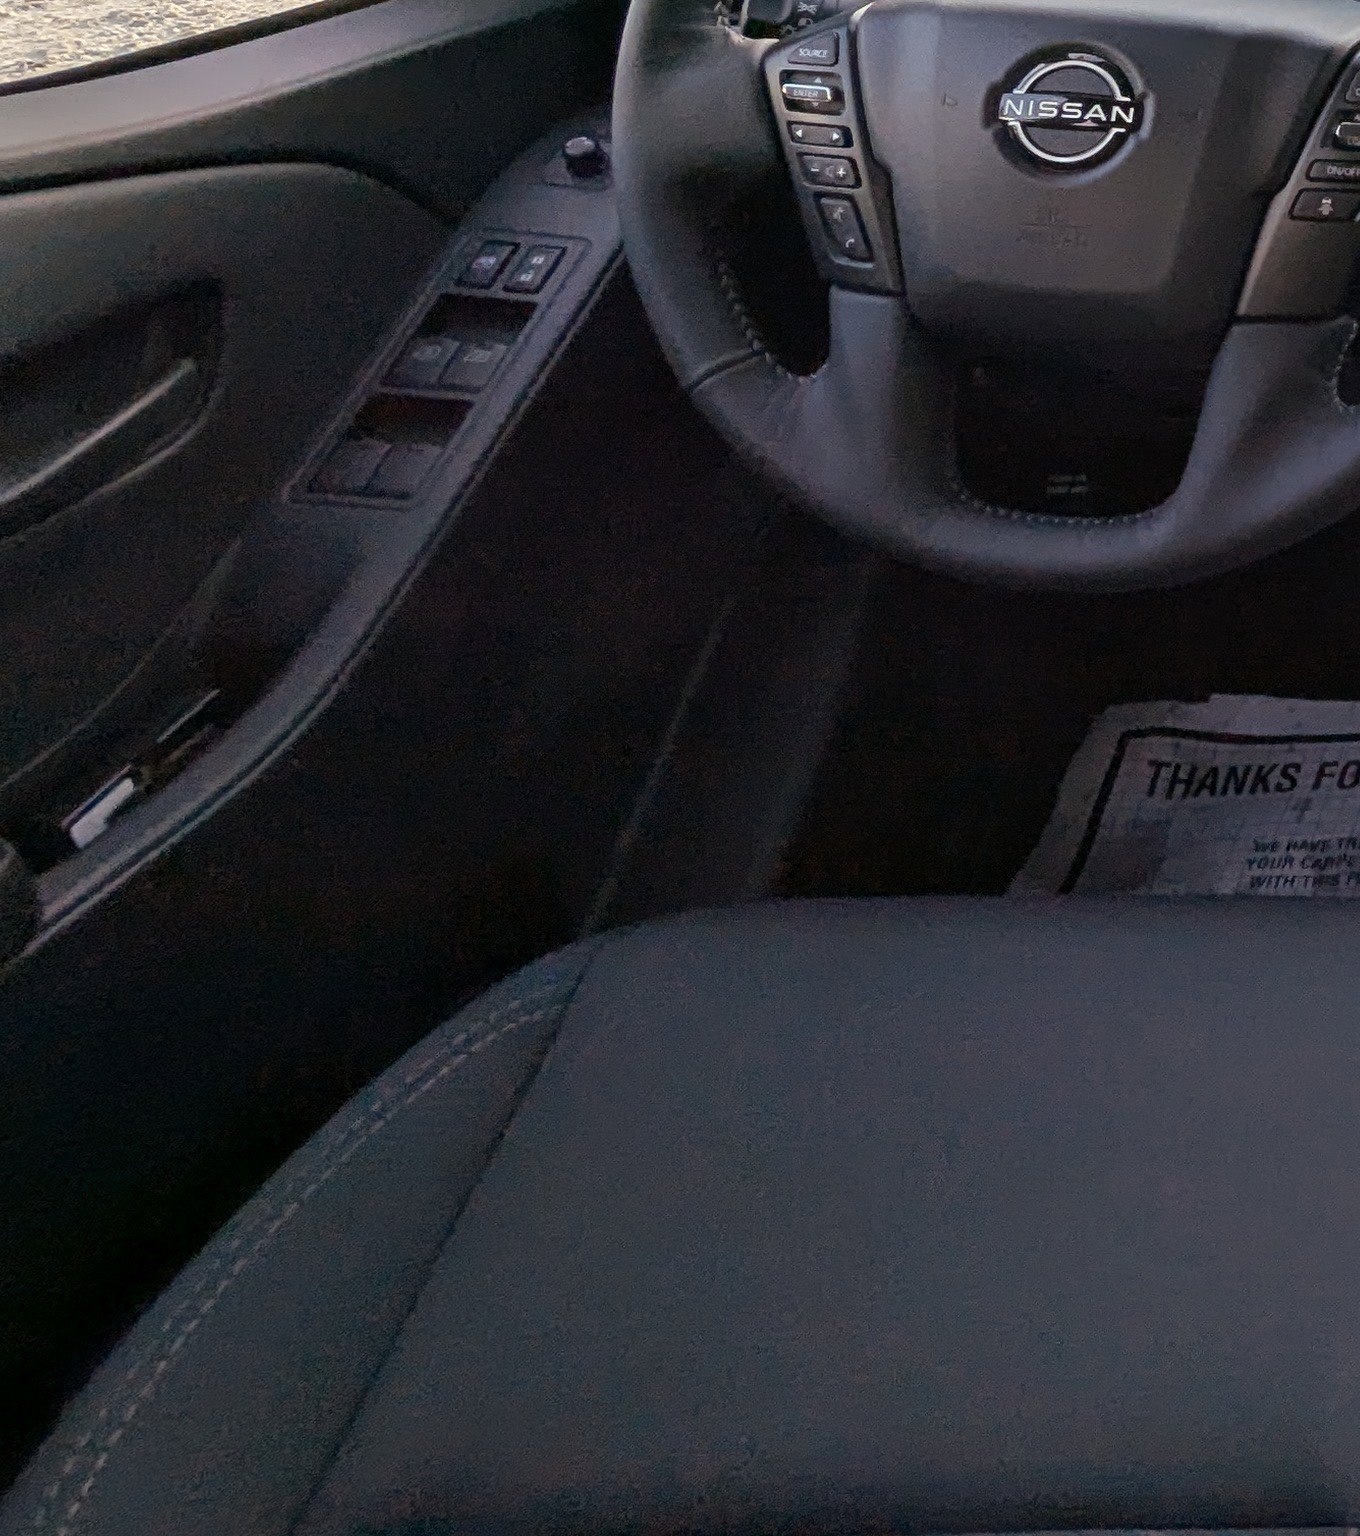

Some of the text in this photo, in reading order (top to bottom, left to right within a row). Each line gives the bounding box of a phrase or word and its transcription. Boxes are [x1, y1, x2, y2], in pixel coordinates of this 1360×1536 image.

[799, 48, 828, 58] SOURCE
[1002, 97, 1136, 123] NISSAN
[1145, 757, 1301, 801] THANKS
[1246, 854, 1296, 870] YOUR
[1249, 875, 1297, 890] WITH
